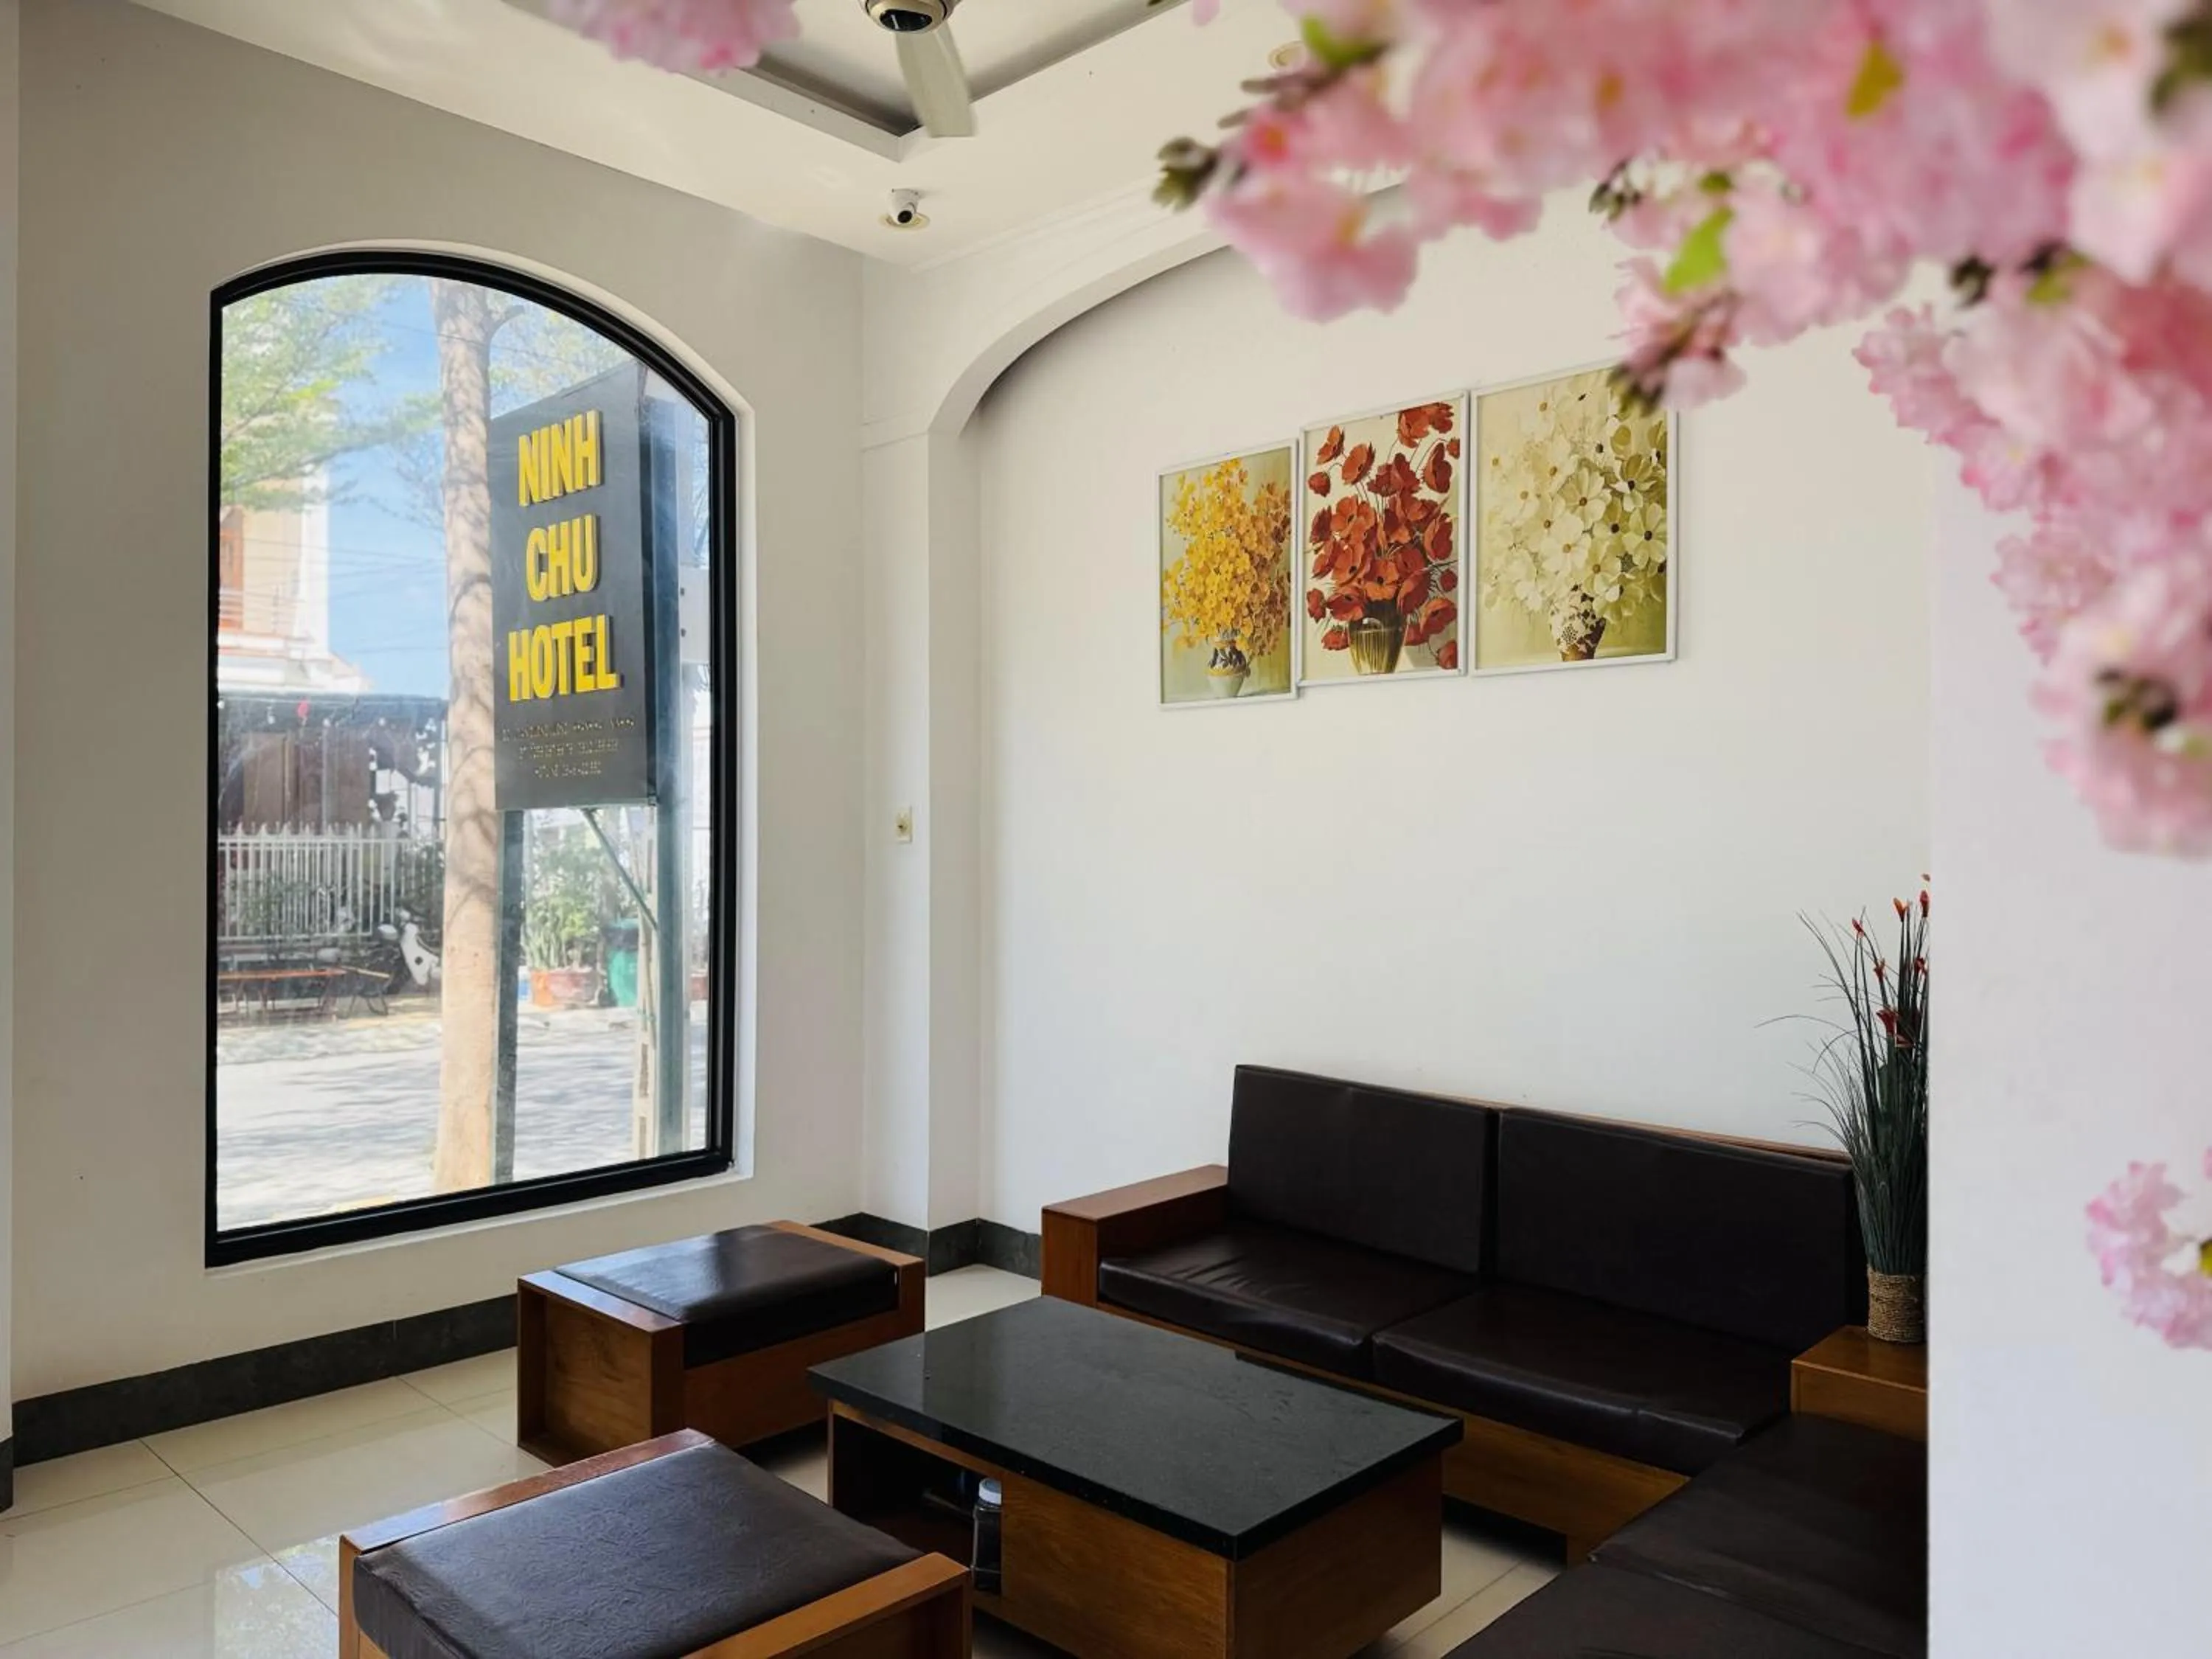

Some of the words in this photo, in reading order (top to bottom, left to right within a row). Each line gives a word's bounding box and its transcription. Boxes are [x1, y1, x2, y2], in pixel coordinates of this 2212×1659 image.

[518, 409, 602, 507] NINH
[526, 513, 599, 602] CHU
[508, 613, 620, 702] HOTEL
